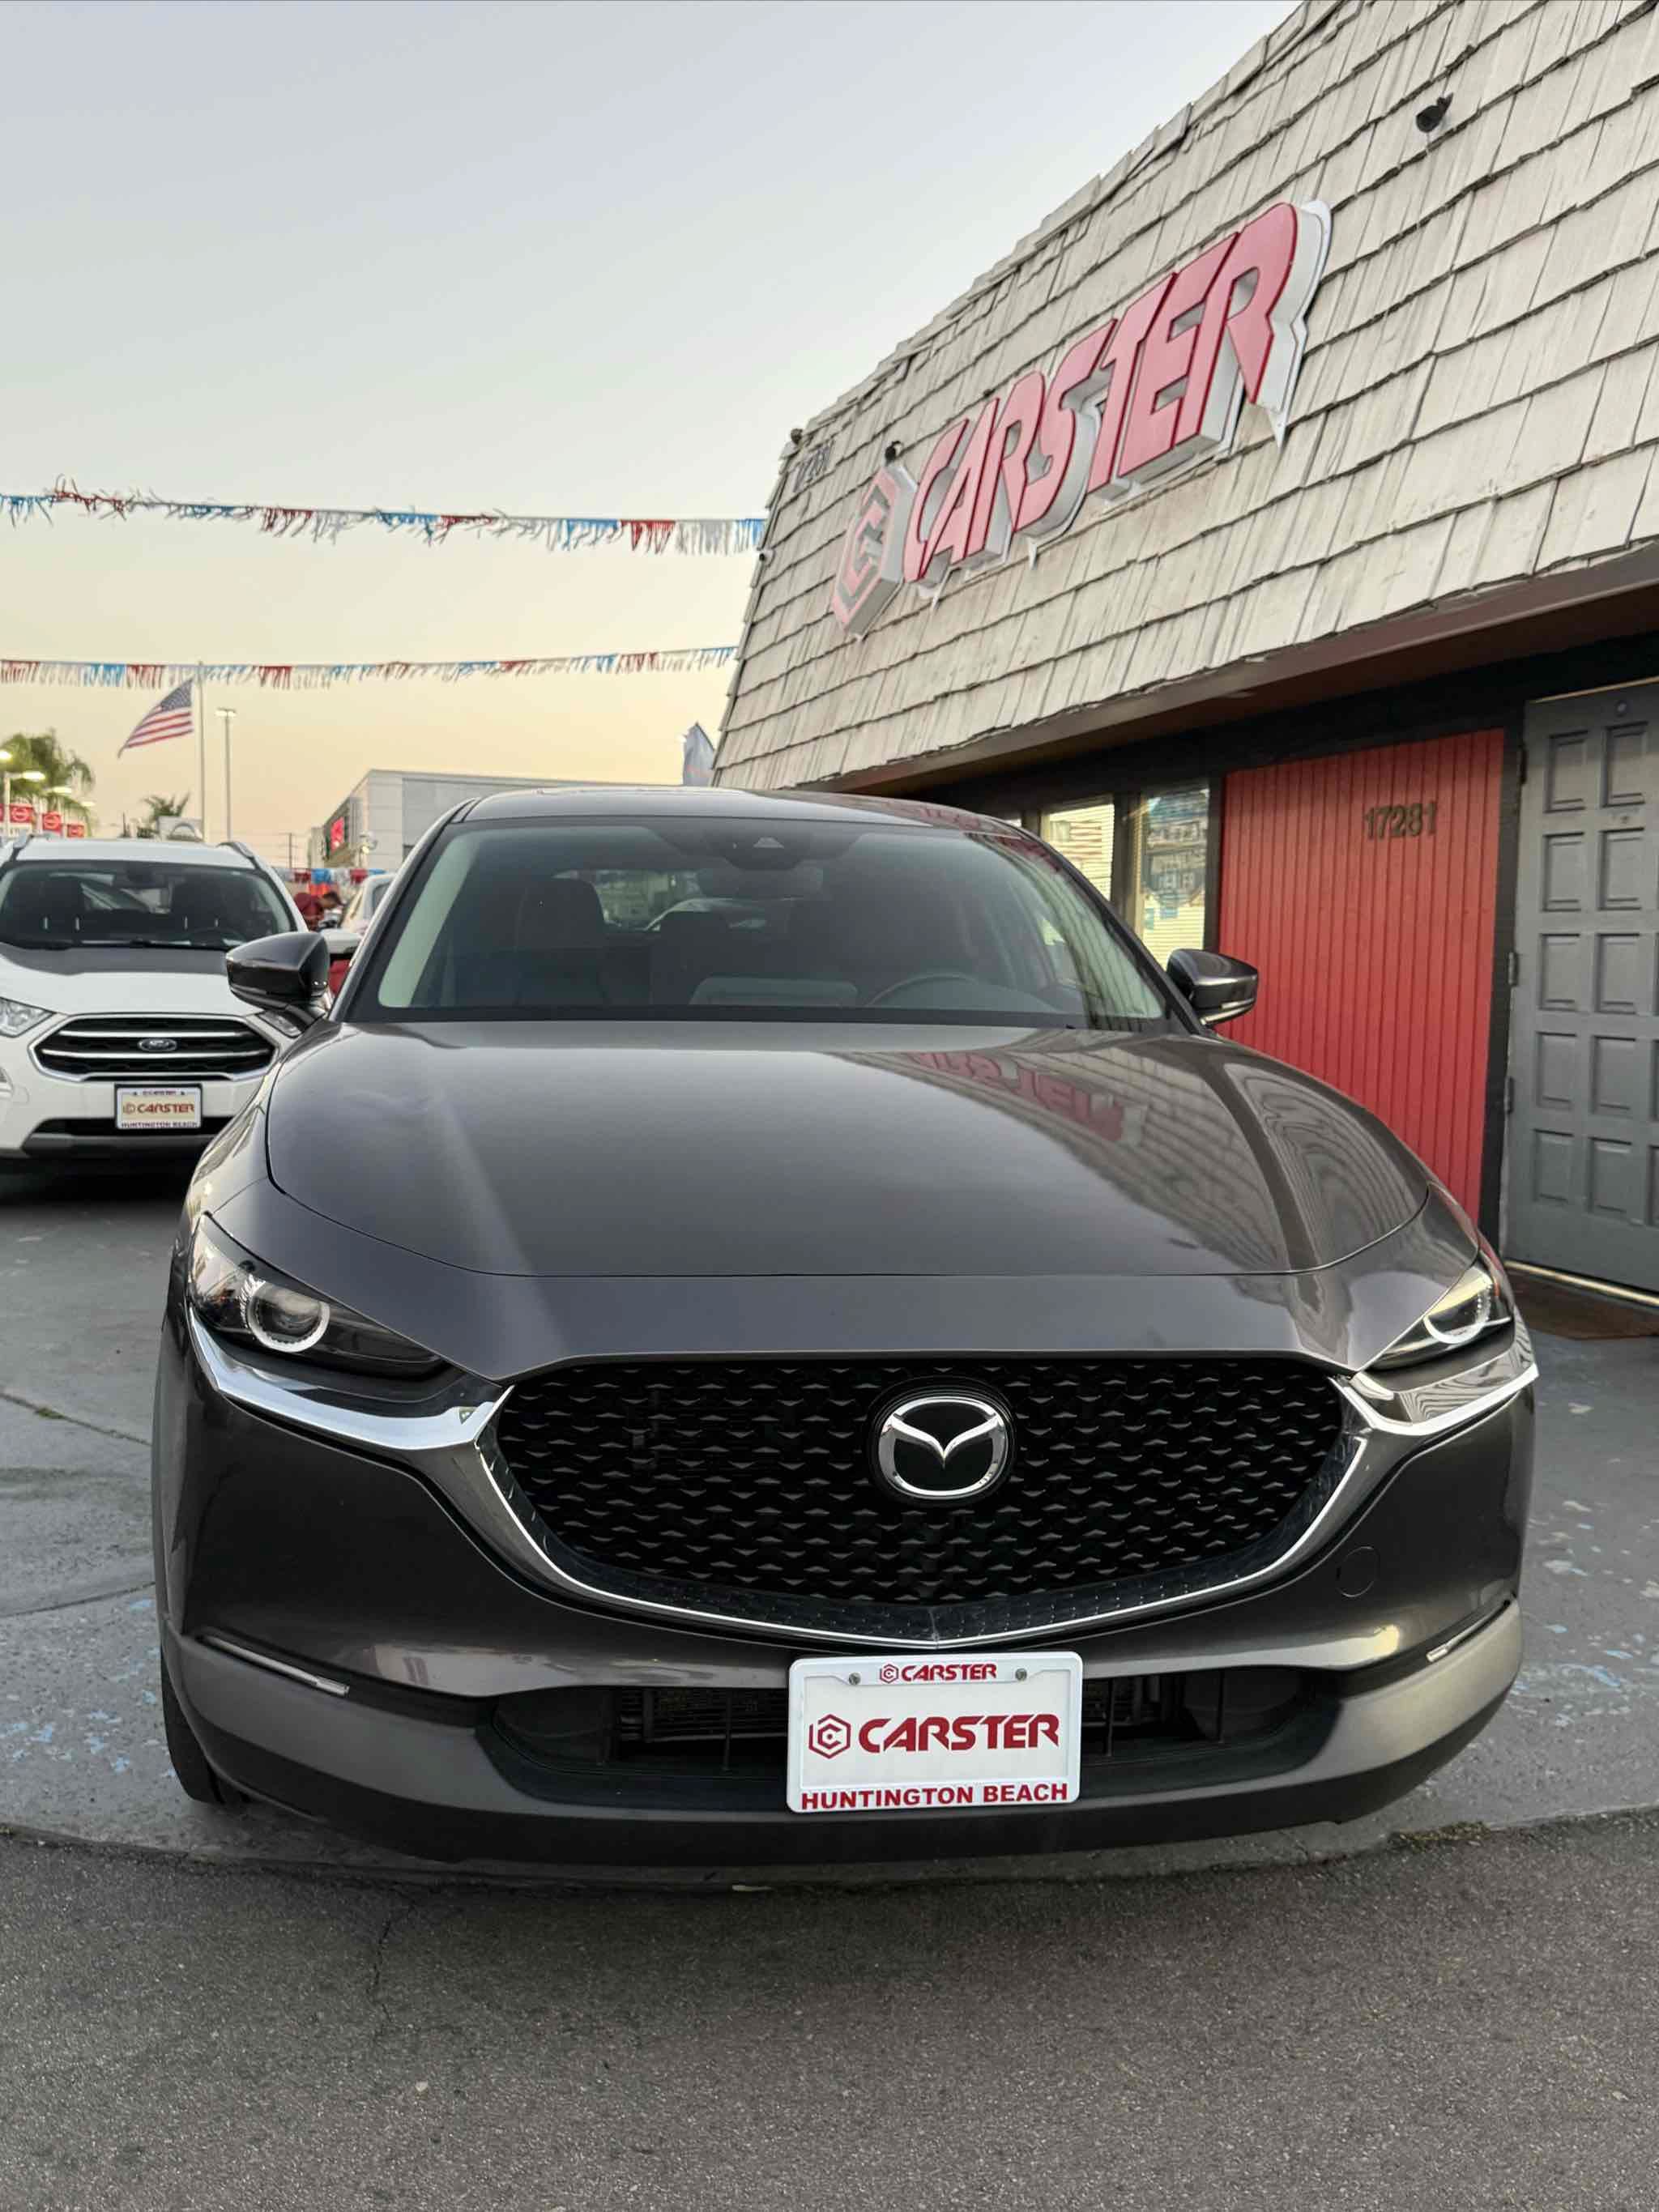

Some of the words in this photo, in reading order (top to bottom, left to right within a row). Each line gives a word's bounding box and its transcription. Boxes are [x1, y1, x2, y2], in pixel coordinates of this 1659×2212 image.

[902, 202, 1306, 583] CARSTER
[1365, 801, 1436, 838] 17281
[137, 1103, 195, 1114] CARSTER
[901, 1664, 996, 1681] CARSTER
[859, 1714, 1060, 1754] CARSTER
[801, 1787, 974, 1810] HUNTINGTON
[983, 1783, 1068, 1803] BEACH
